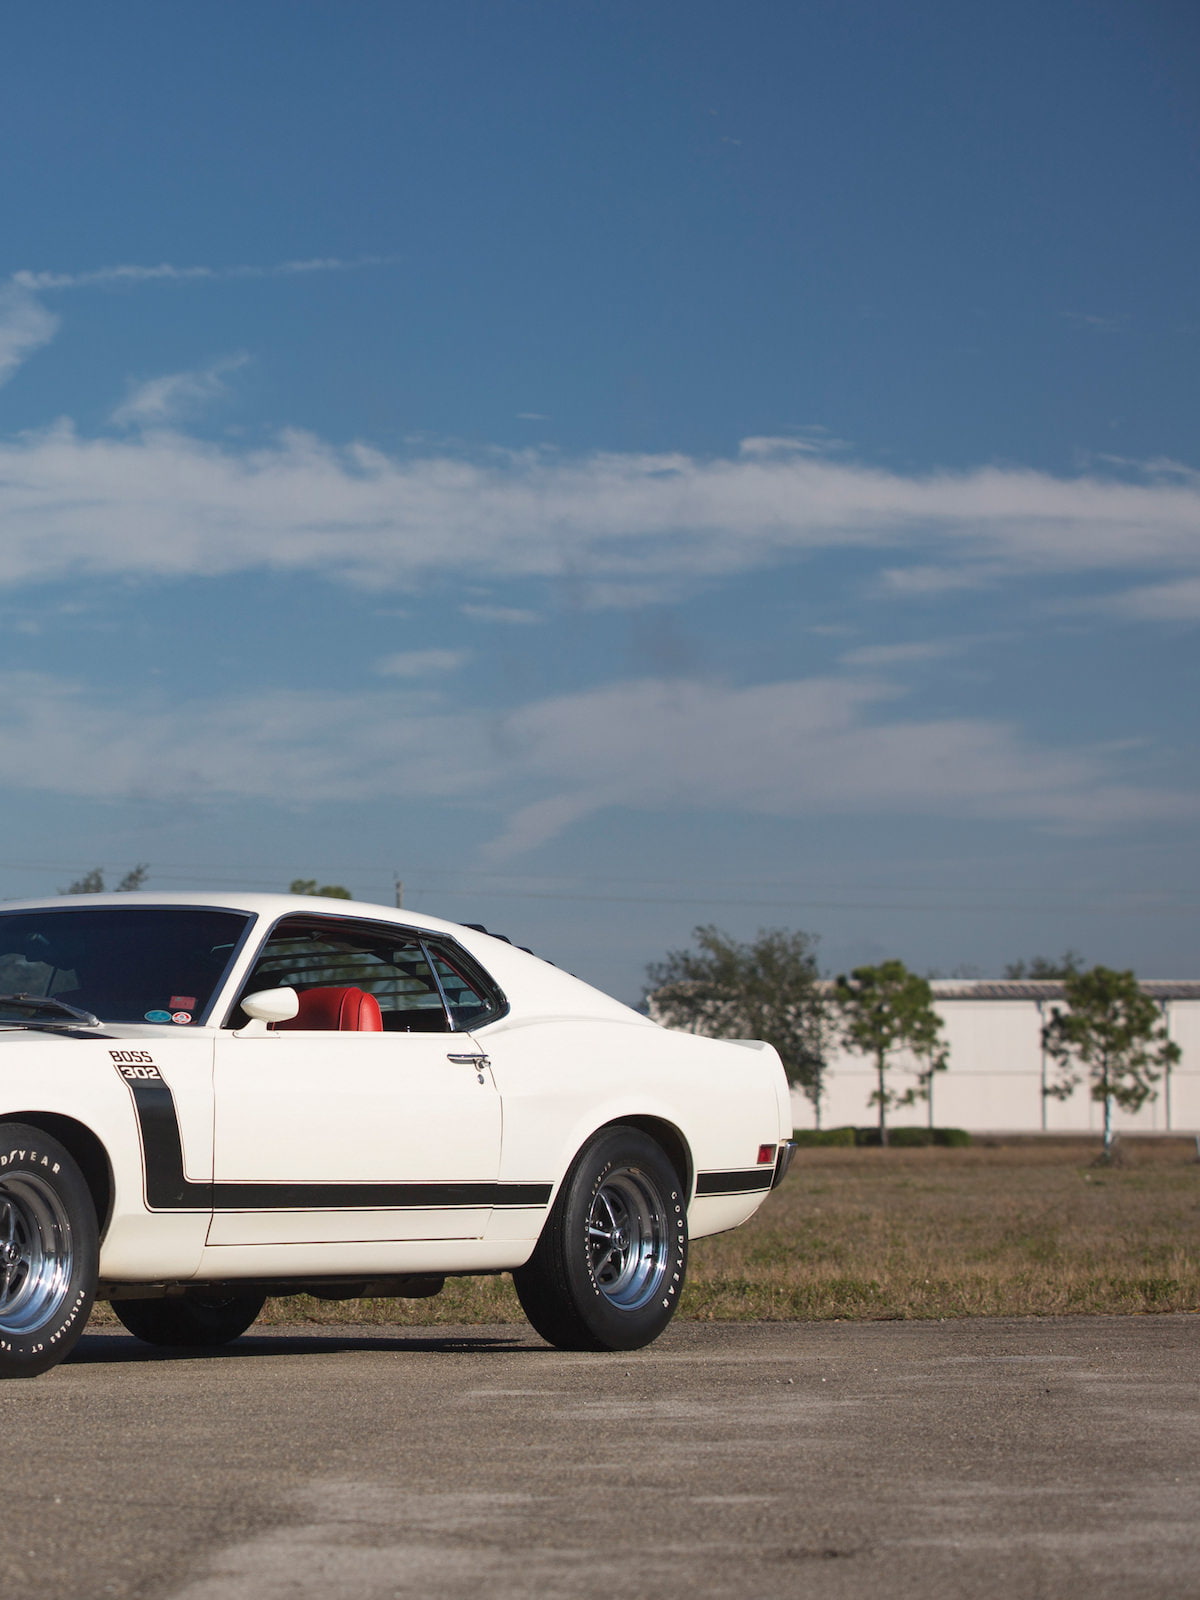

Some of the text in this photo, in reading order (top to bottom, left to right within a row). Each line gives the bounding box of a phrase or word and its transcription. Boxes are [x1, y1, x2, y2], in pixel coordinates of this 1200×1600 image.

[109, 1050, 153, 1063] BOSS
[120, 1066, 161, 1079] 302
[662, 1191, 684, 1308] GOODYEAR
[49, 1290, 86, 1344] POLYGLAS
[31, 1343, 44, 1353] GT
